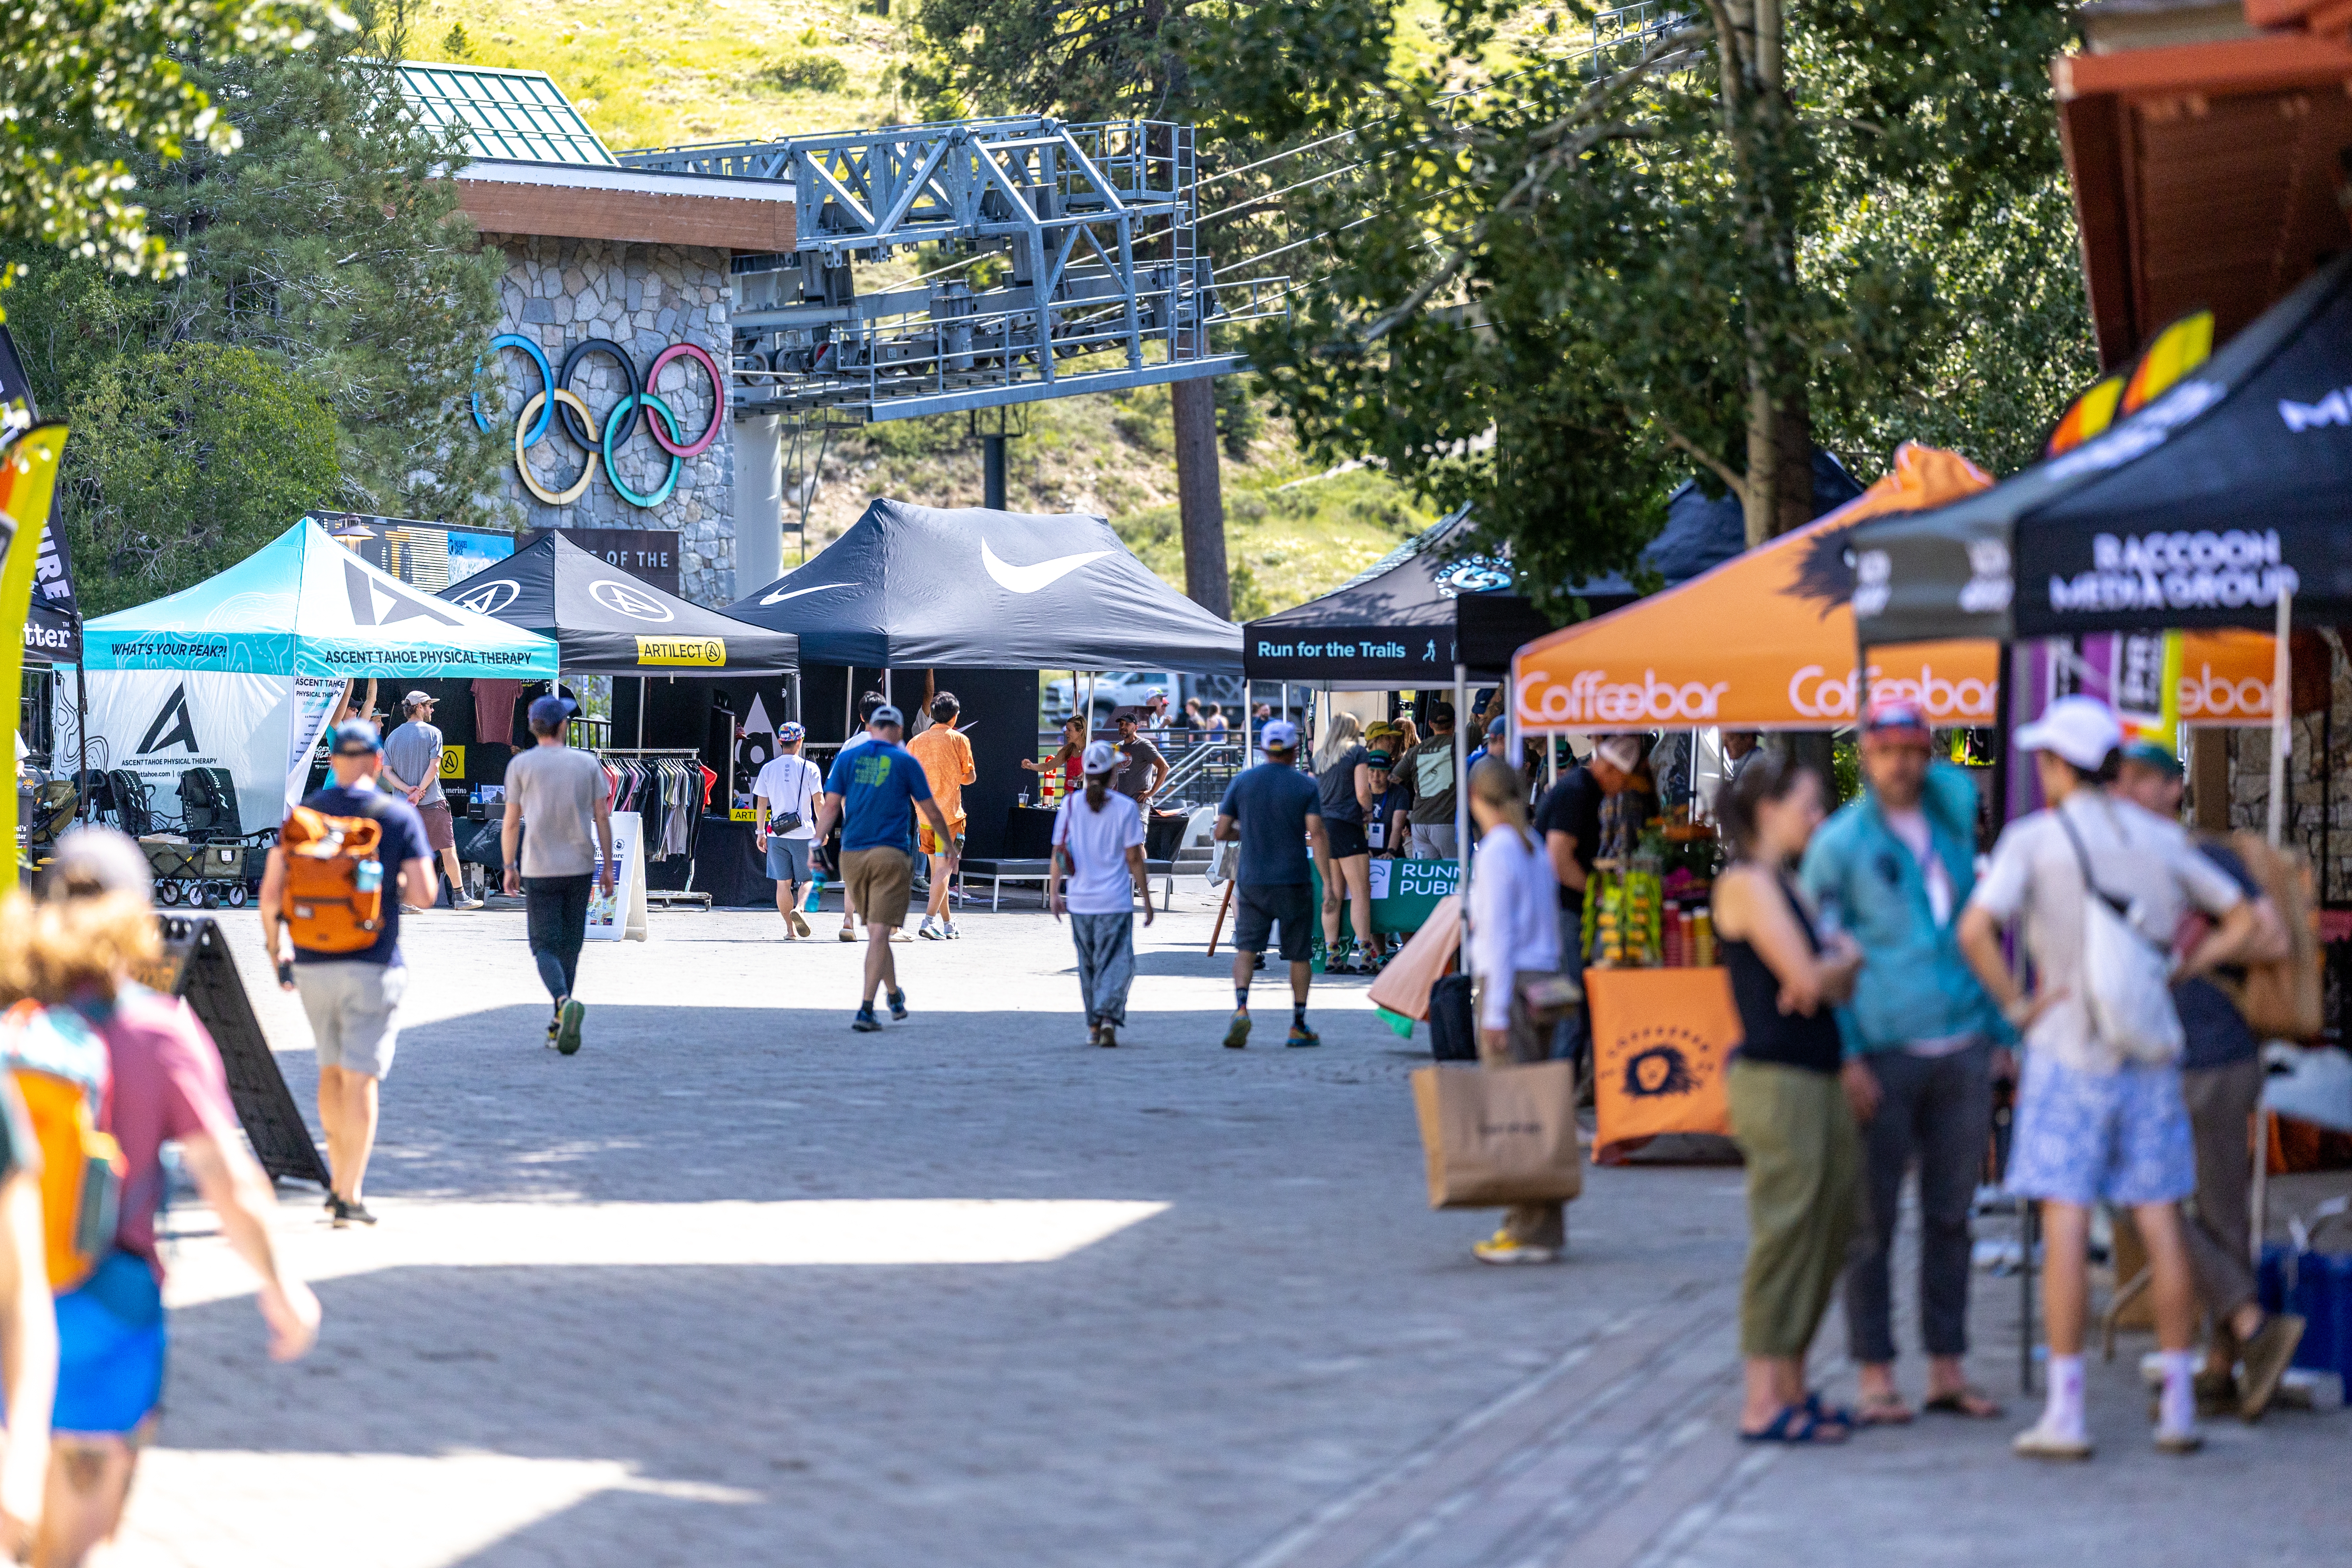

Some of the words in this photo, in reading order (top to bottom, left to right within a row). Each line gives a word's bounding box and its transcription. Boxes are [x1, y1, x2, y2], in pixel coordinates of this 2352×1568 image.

[606, 550, 628, 566] OF
[637, 551, 668, 567] THE
[2093, 528, 2281, 572] RACCOON
[21, 622, 71, 648] tter
[111, 643, 154, 656] WHAT'S
[157, 643, 188, 656] YOUR
[188, 644, 227, 657] PEAK?!
[325, 651, 373, 664] ASCENT
[376, 651, 418, 664] TAHOE
[420, 651, 478, 664] PHYSICAL
[479, 652, 532, 665] THERAPY
[644, 643, 702, 658] ARTILECT
[1258, 641, 1294, 657] Run
[1296, 641, 1323, 657] for
[1325, 641, 1356, 657] the
[1359, 641, 1407, 658] Trails
[295, 678, 324, 687] ASCENT
[1515, 669, 1730, 723] Coffeebar
